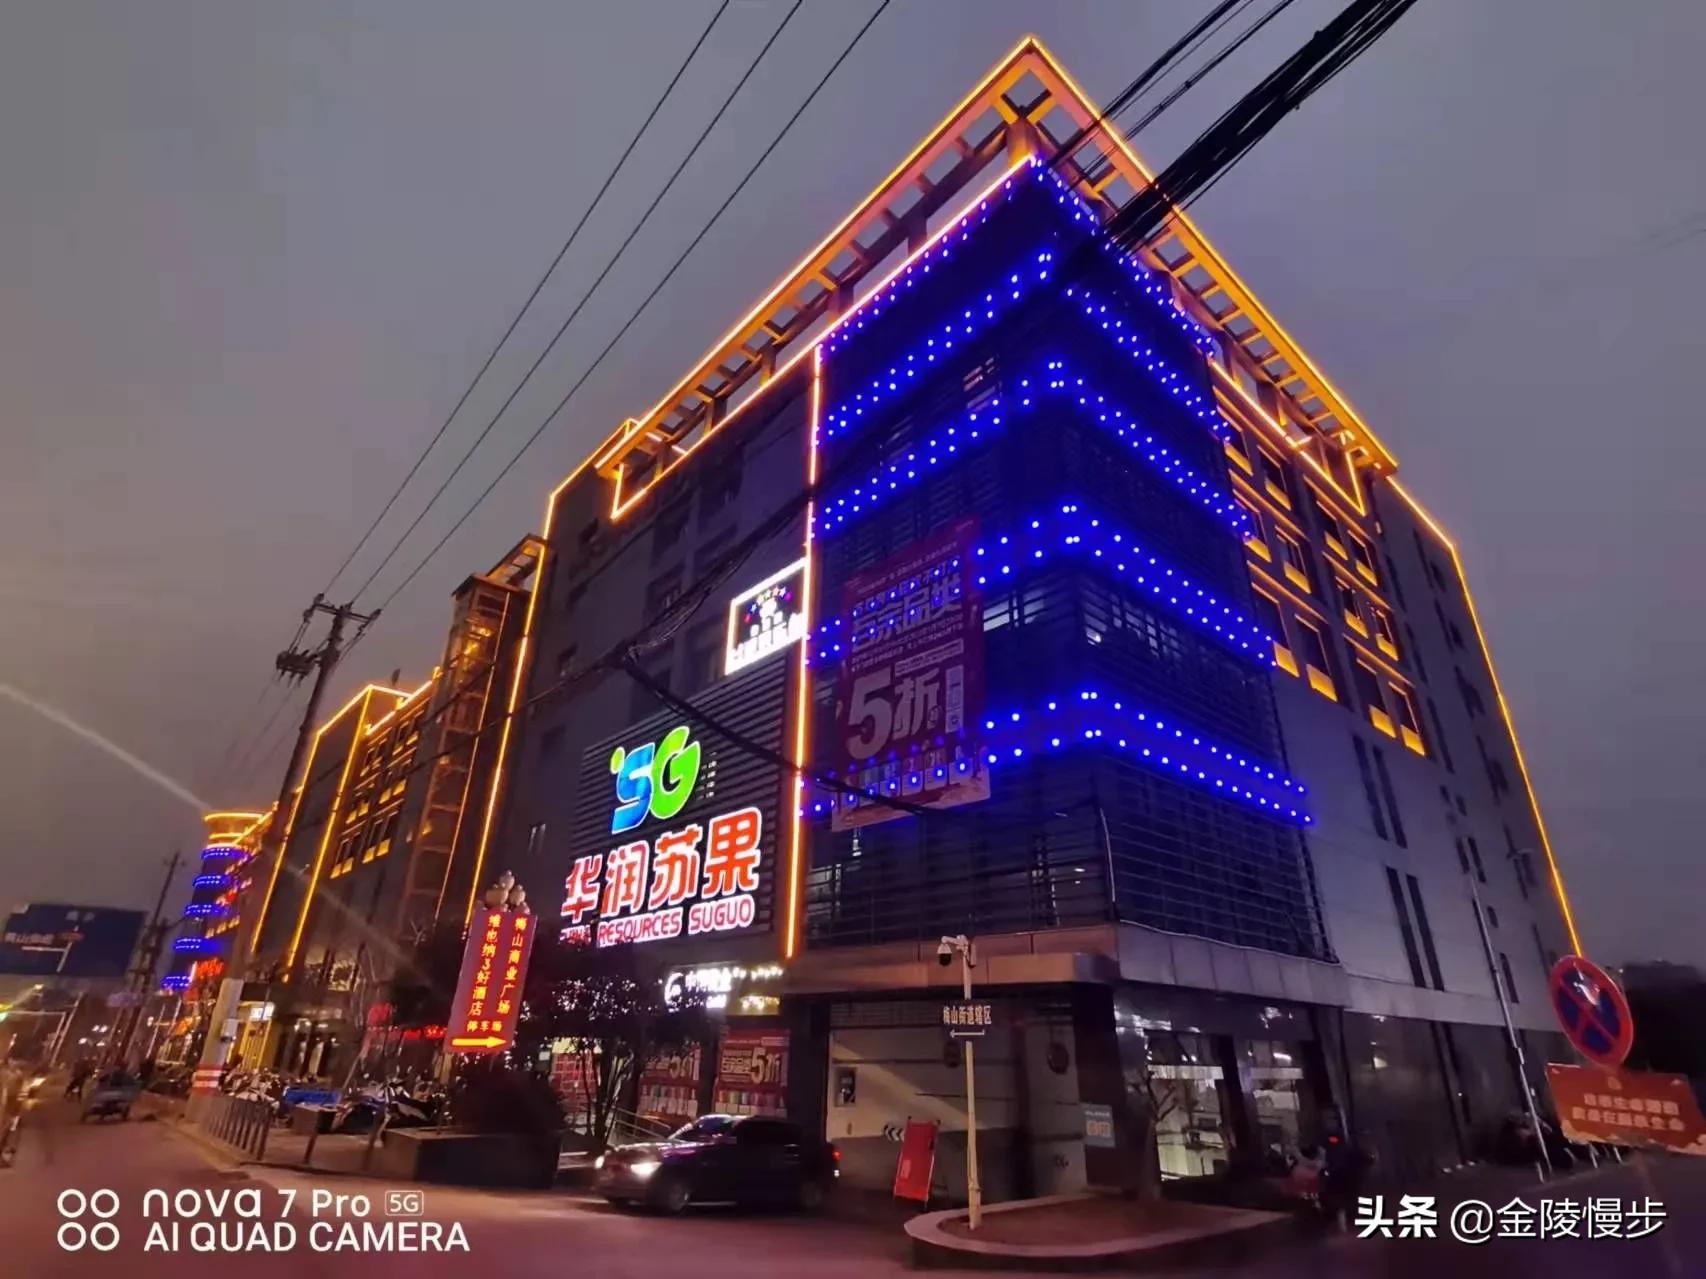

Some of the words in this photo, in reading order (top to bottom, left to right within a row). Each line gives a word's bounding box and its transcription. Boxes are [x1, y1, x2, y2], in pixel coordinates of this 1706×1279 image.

[560, 807, 762, 923] 华润苏果
[467, 914, 502, 1016] 维也纳3好酒店
[496, 917, 528, 1015] 梅山商业广场
[598, 908, 684, 948] RESOURCES
[688, 894, 755, 934] SUGUO
